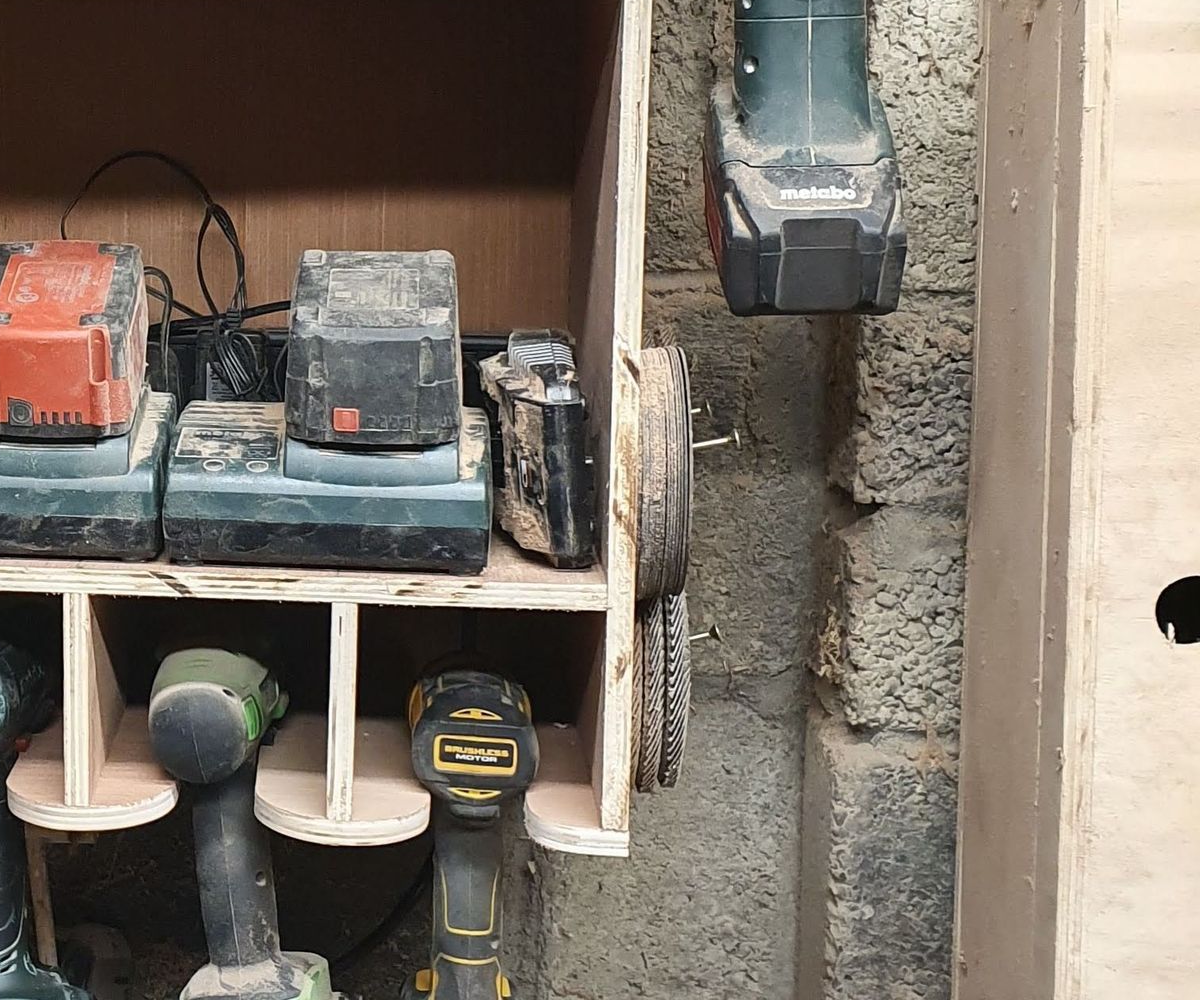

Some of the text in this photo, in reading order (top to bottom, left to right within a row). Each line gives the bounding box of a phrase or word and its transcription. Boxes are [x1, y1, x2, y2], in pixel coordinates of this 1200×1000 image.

[779, 185, 857, 201] metabo
[444, 744, 510, 758] BRUSHLESS
[455, 753, 498, 763] MOTOR
